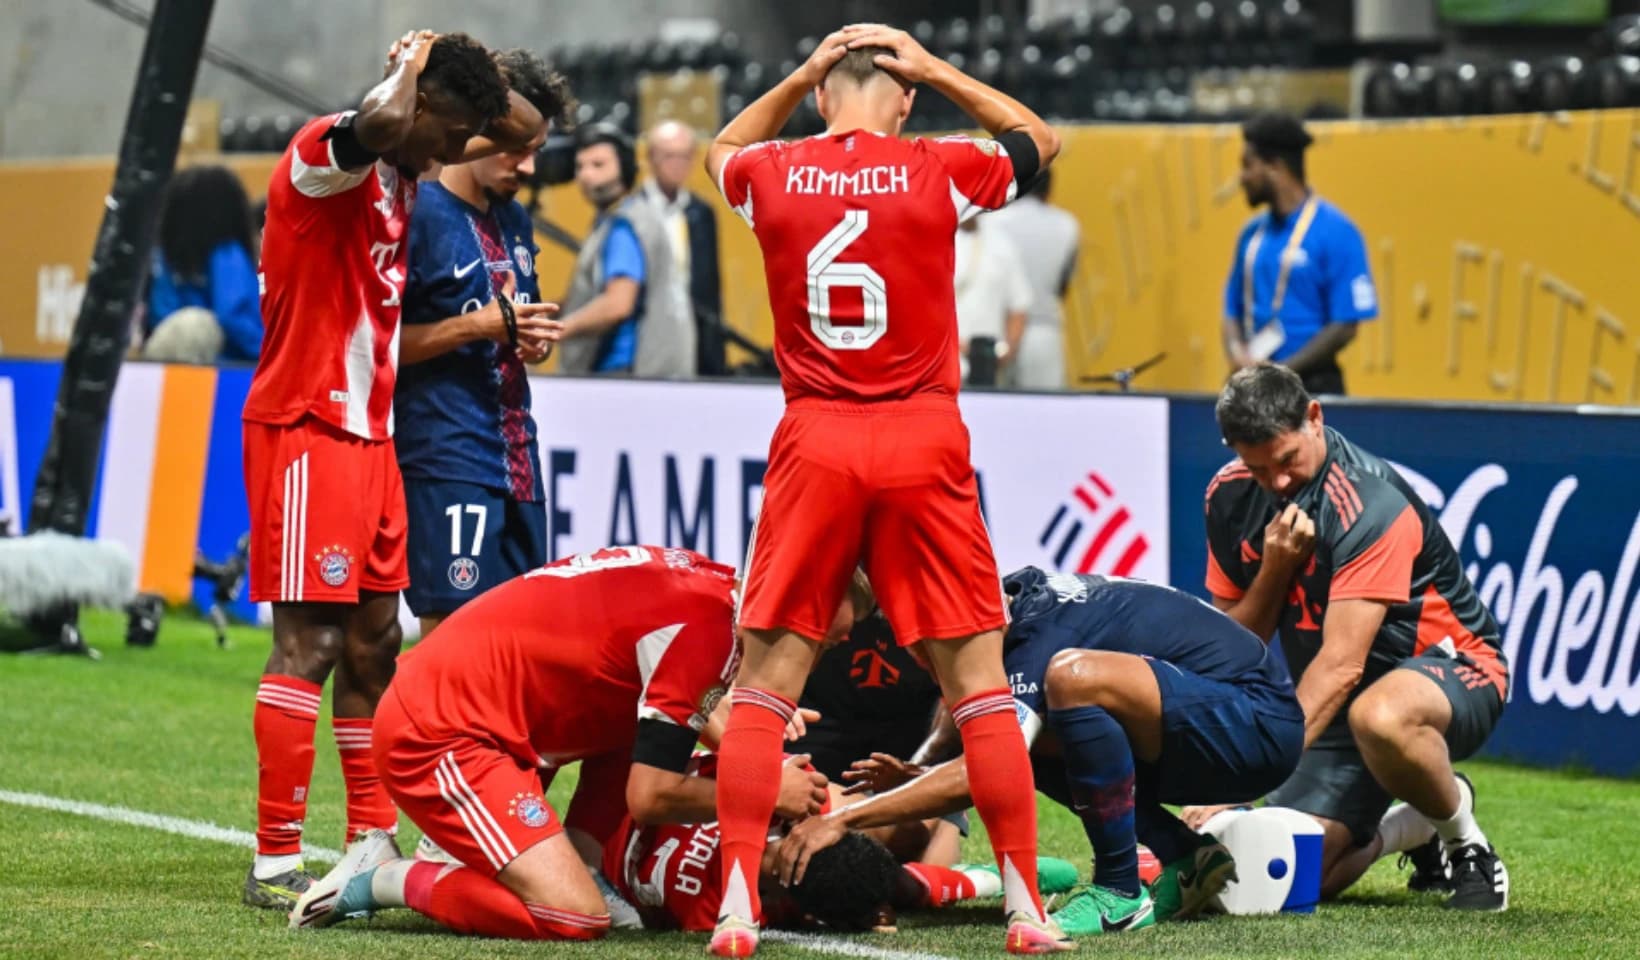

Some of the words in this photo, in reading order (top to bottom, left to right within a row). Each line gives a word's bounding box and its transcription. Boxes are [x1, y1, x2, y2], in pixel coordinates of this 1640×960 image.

[785, 165, 910, 197] KIMMICH
[806, 210, 888, 349] 6
[445, 503, 488, 557] 17
